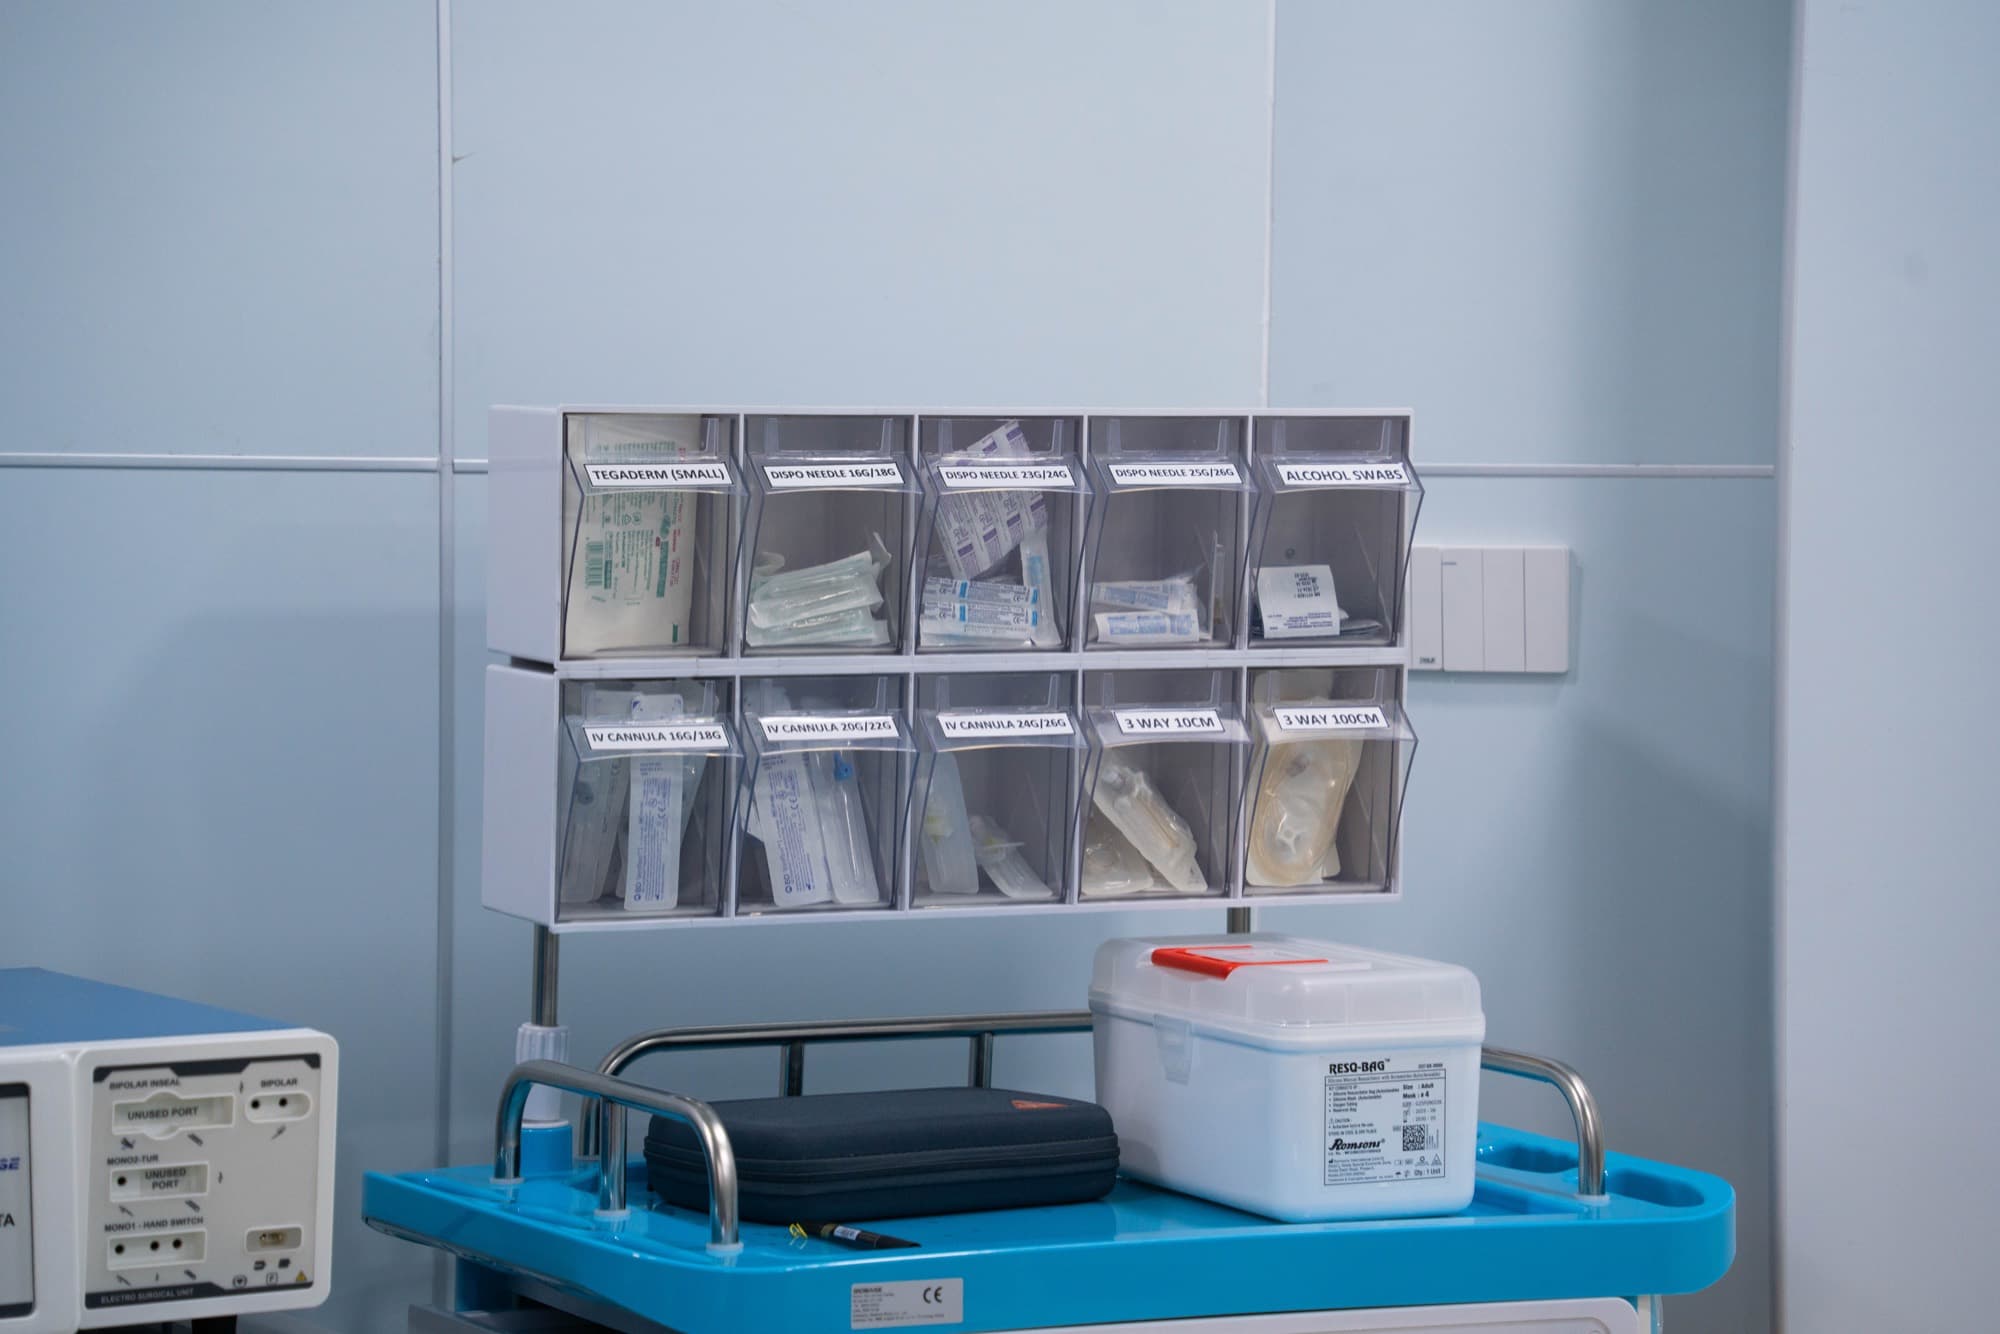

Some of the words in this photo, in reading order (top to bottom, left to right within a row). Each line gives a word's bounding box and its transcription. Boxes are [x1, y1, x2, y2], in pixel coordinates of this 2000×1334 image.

[592, 469, 669, 480] TEGADERM
[671, 468, 725, 481] (SMALL)
[770, 470, 804, 479] DISPO
[806, 469, 847, 479] NEEDLE
[849, 468, 896, 479] 16G/18G
[945, 471, 978, 480] DISPO
[980, 470, 1020, 480] NEEDLE
[1021, 469, 1068, 480] 23G/24G
[1115, 469, 1147, 477] DISPO
[1149, 468, 1187, 477] NEEDLE
[1188, 467, 1235, 478] 25G/26G
[1286, 470, 1351, 481] ALCOHOL
[1352, 469, 1403, 480] SWABS
[945, 721, 957, 730] IV
[959, 720, 1015, 730] CANNULA
[1018, 718, 1067, 729] 24G/26G
[1124, 718, 1134, 729] 3
[1136, 718, 1170, 729] WAY
[1174, 717, 1215, 728] 10CM
[1283, 715, 1293, 726] 3
[1294, 714, 1328, 725] WAY
[1331, 713, 1380, 725] 100CM
[767, 725, 779, 733] IV
[782, 723, 839, 733] CANNULA
[840, 721, 892, 732] 20G/22G
[591, 733, 604, 742] IV
[607, 732, 667, 742] CANNULA
[669, 730, 722, 742] 16G/18G
[109, 1080, 148, 1090] BIPOLAR
[260, 1077, 298, 1089] BIPOLAR
[127, 1108, 169, 1121] UNUSED
[171, 1105, 199, 1118] PORT
[144, 1167, 187, 1180] UNUSED
[151, 1180, 179, 1191] PORT
[104, 1221, 136, 1232] MONO1
[143, 1219, 168, 1230] HAND
[169, 1216, 204, 1227] SWITCH
[101, 1293, 137, 1304] ELECTRO
[138, 1289, 175, 1301] SURGICAL
[176, 1287, 194, 1298] UNIT
